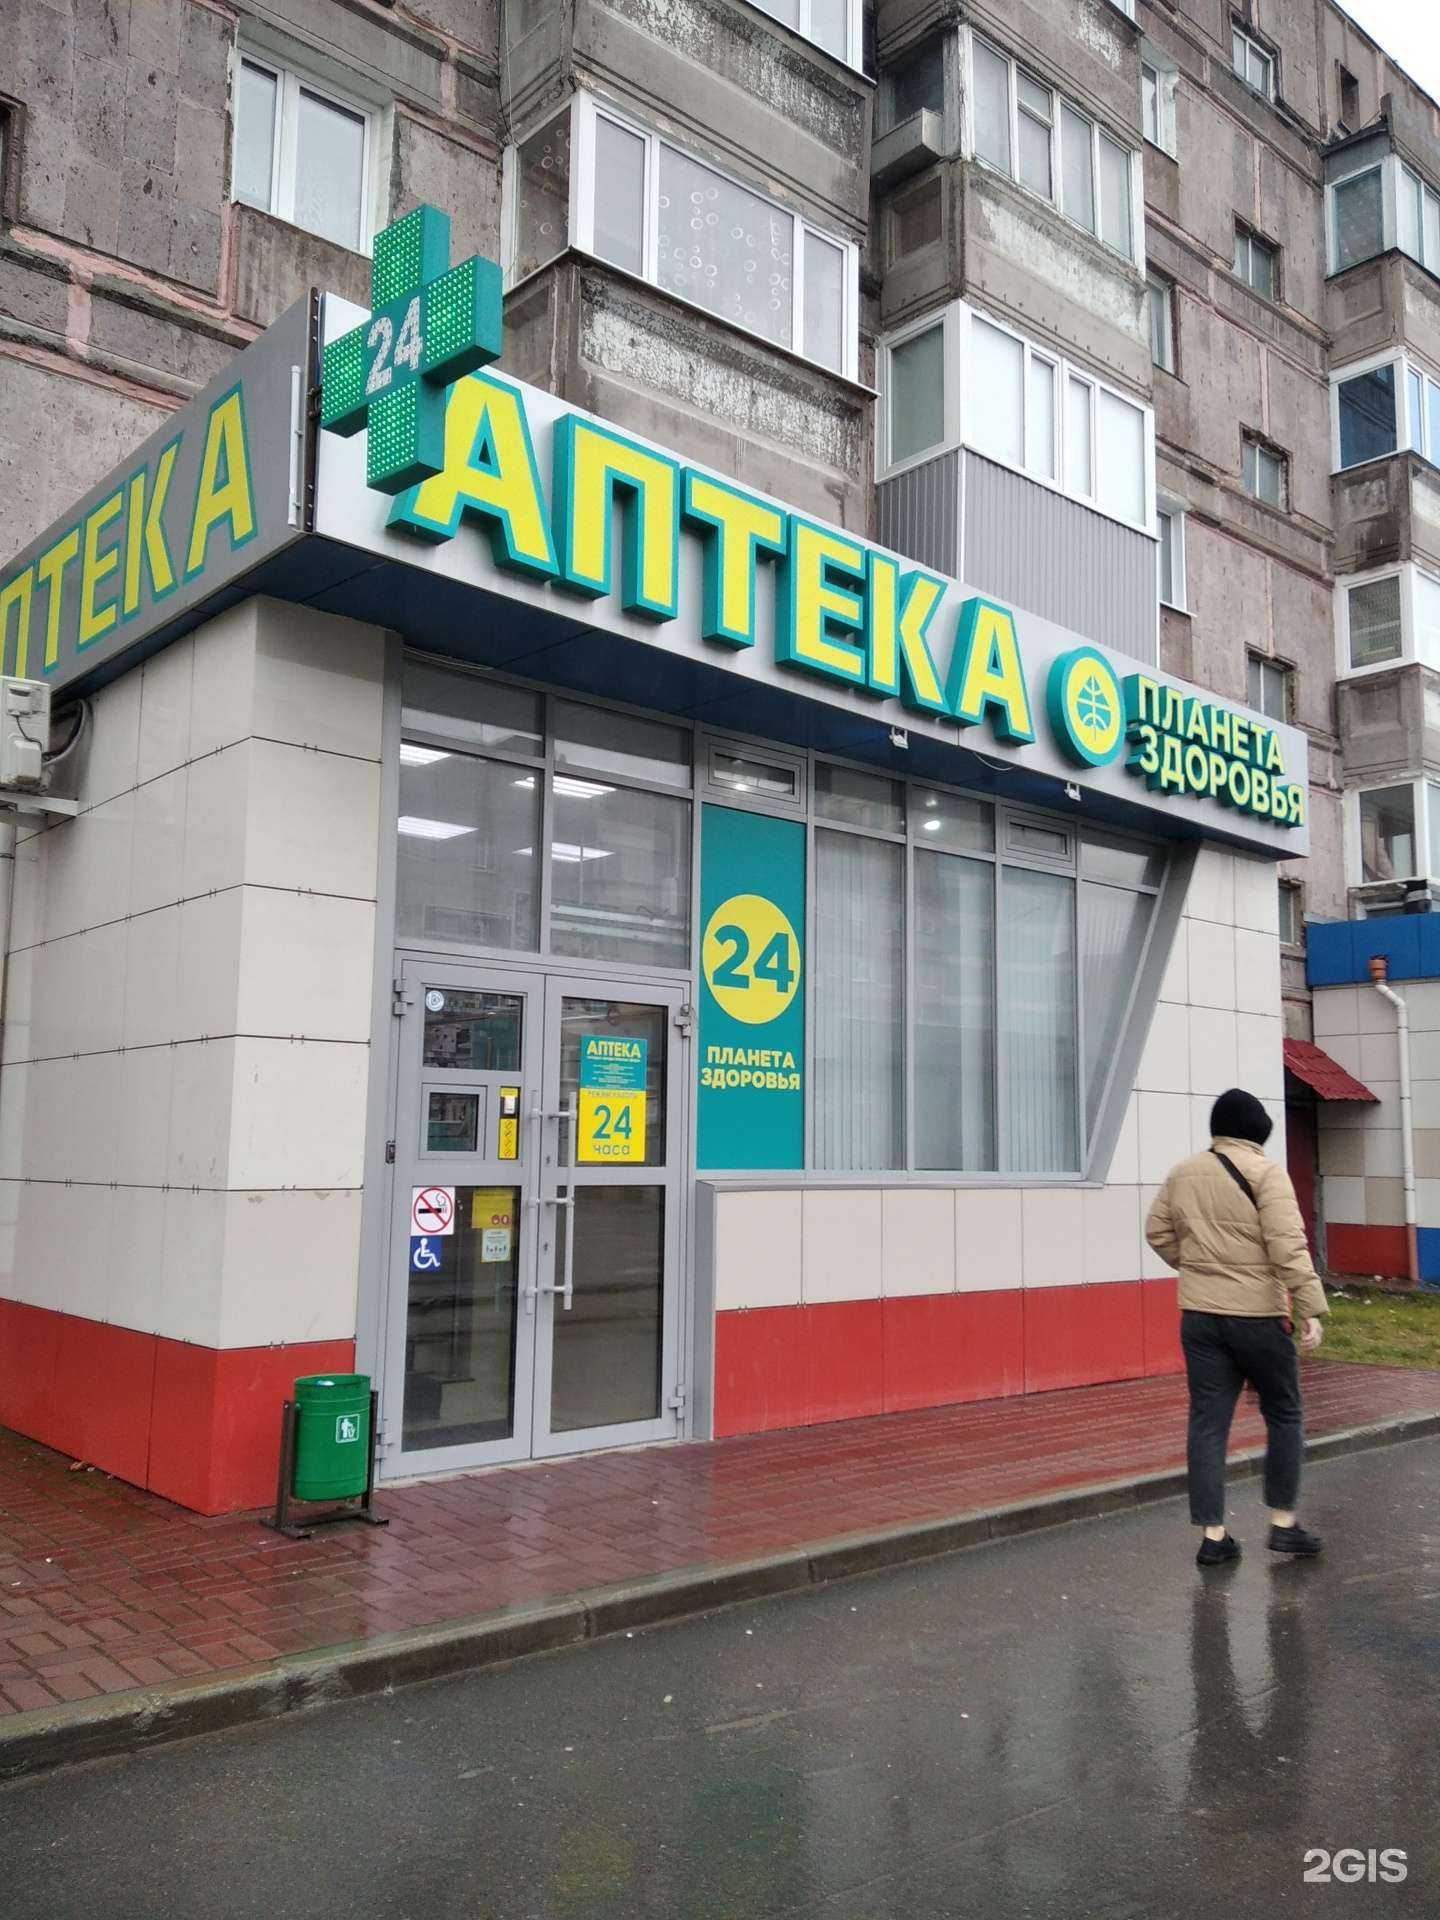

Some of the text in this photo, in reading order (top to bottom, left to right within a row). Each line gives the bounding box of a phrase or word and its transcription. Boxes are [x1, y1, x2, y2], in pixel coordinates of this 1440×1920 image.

[365, 296, 422, 395] 24
[387, 369, 1034, 744] АПТЕКА
[1128, 674, 1286, 775] ПЛАНЕТА
[1131, 725, 1305, 826] ЗДОРОВЬЯ
[712, 924, 794, 993] 24
[587, 1040, 641, 1058] АПТЕКА
[701, 1067, 800, 1090] ЗДОРОВЬЯ
[707, 1046, 795, 1068] ПЛАНЕТА
[592, 1104, 632, 1139] 24
